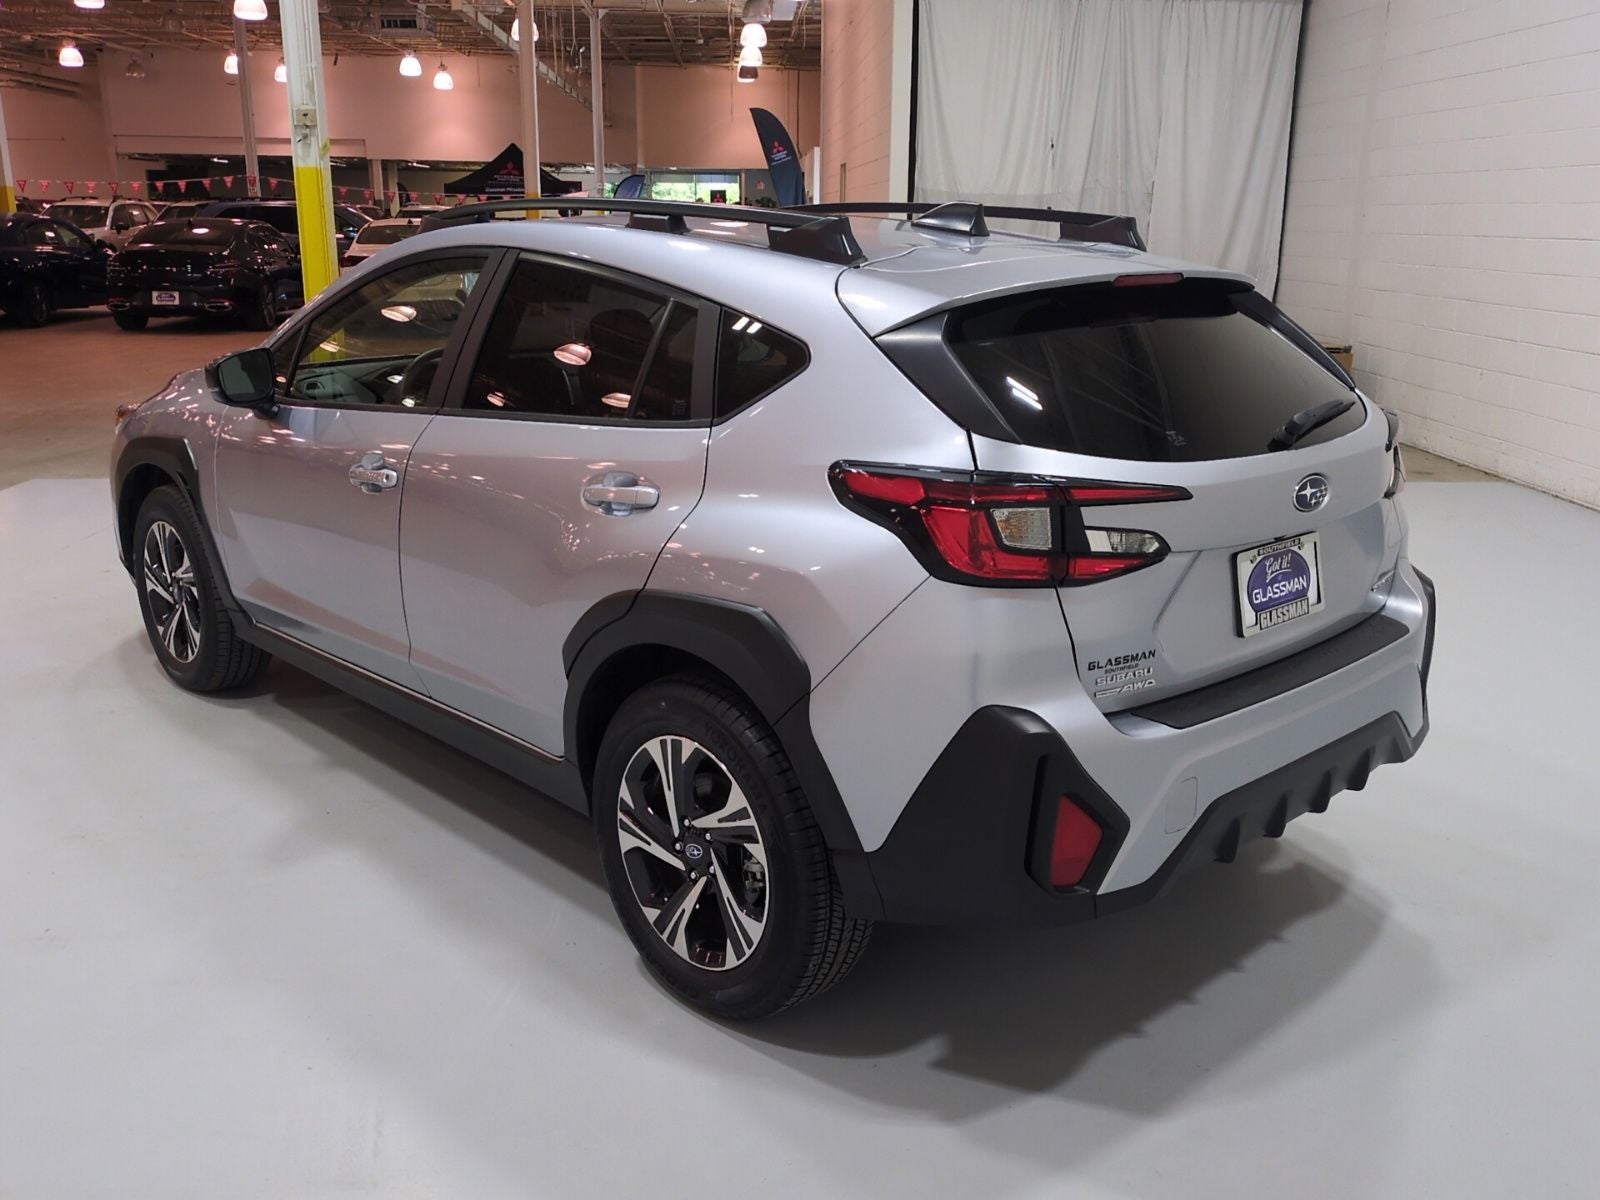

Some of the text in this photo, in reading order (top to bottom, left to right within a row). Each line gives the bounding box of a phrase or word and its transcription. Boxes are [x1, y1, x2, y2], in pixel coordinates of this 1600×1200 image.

[1259, 539, 1299, 556] SOUTHFIELD
[1265, 553, 1292, 577] Got it!
[1253, 575, 1308, 604] GLASSMAN
[1261, 599, 1308, 629] GLASSMAN
[1088, 649, 1156, 671] GLASSMAN
[1096, 667, 1153, 686] SUBARU
[1120, 679, 1156, 694] AWD
